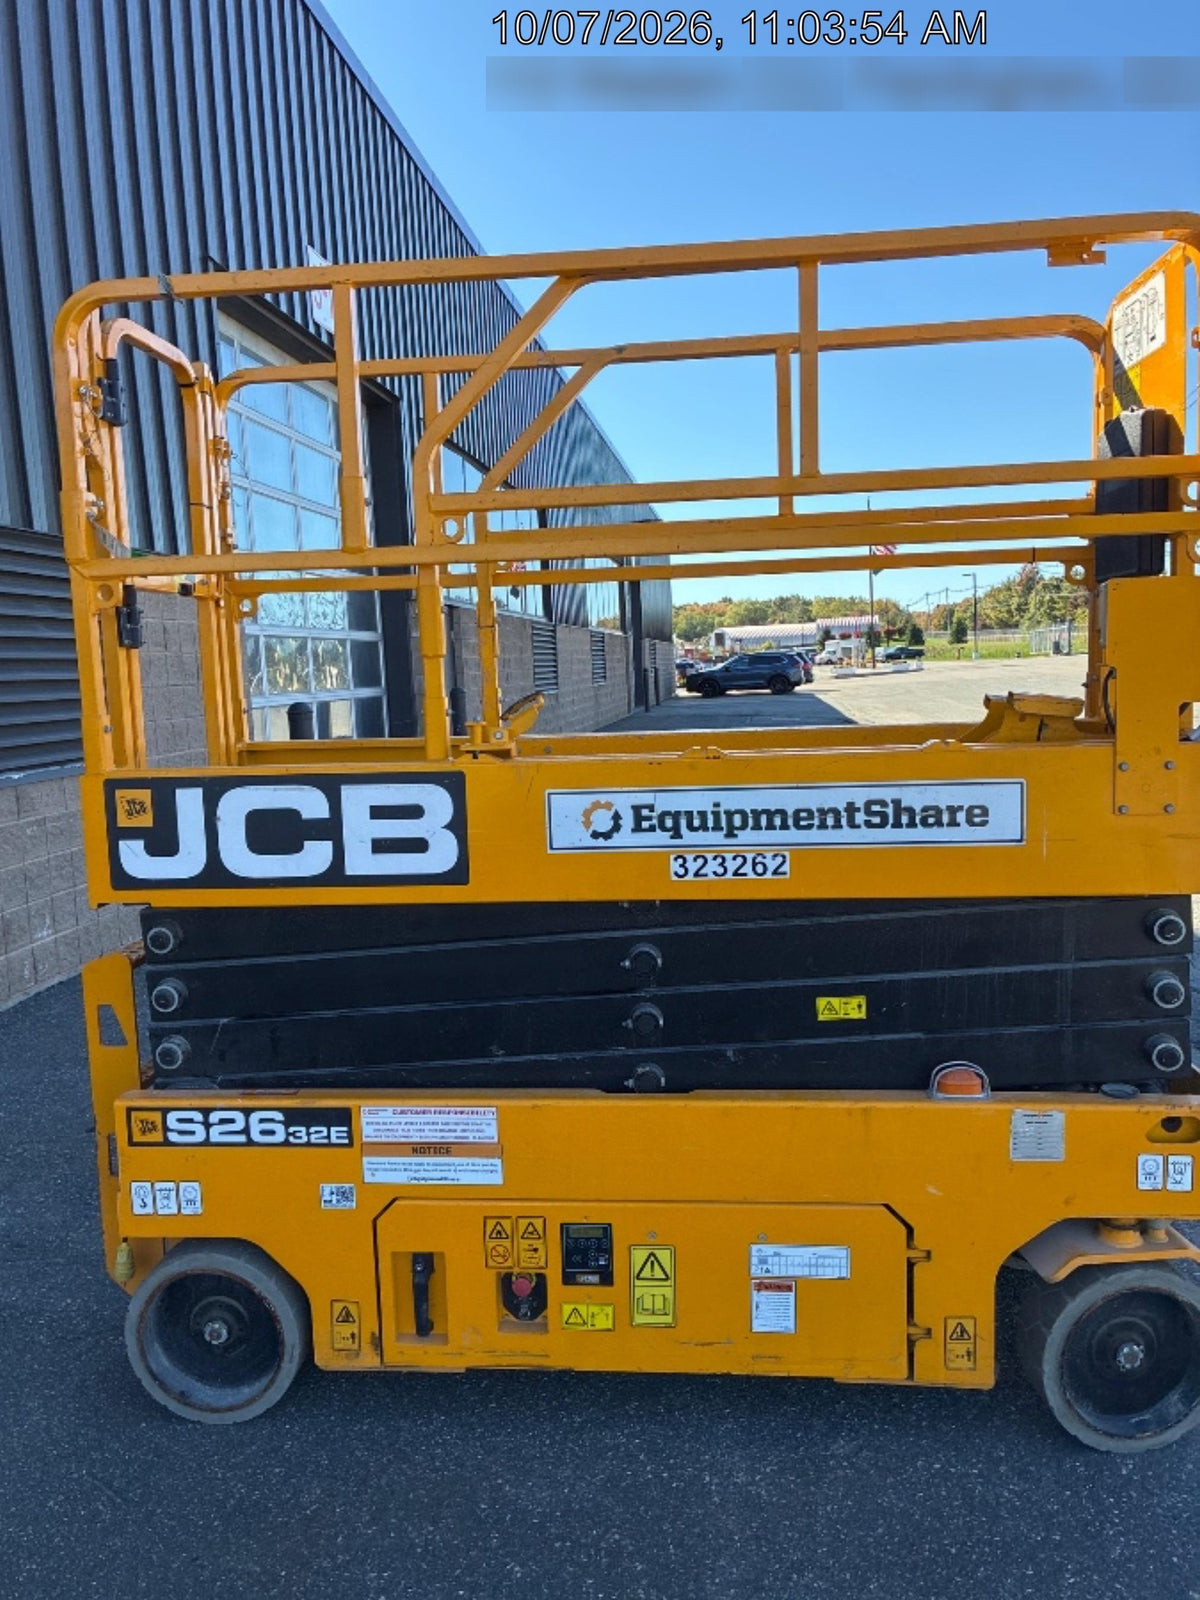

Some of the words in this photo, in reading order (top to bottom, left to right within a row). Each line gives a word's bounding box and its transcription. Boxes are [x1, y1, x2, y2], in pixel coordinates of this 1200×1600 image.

[118, 783, 459, 880] JCB
[630, 798, 990, 839] EquipmentShare
[672, 852, 789, 879] 323262
[412, 1146, 453, 1156] NOTICE
